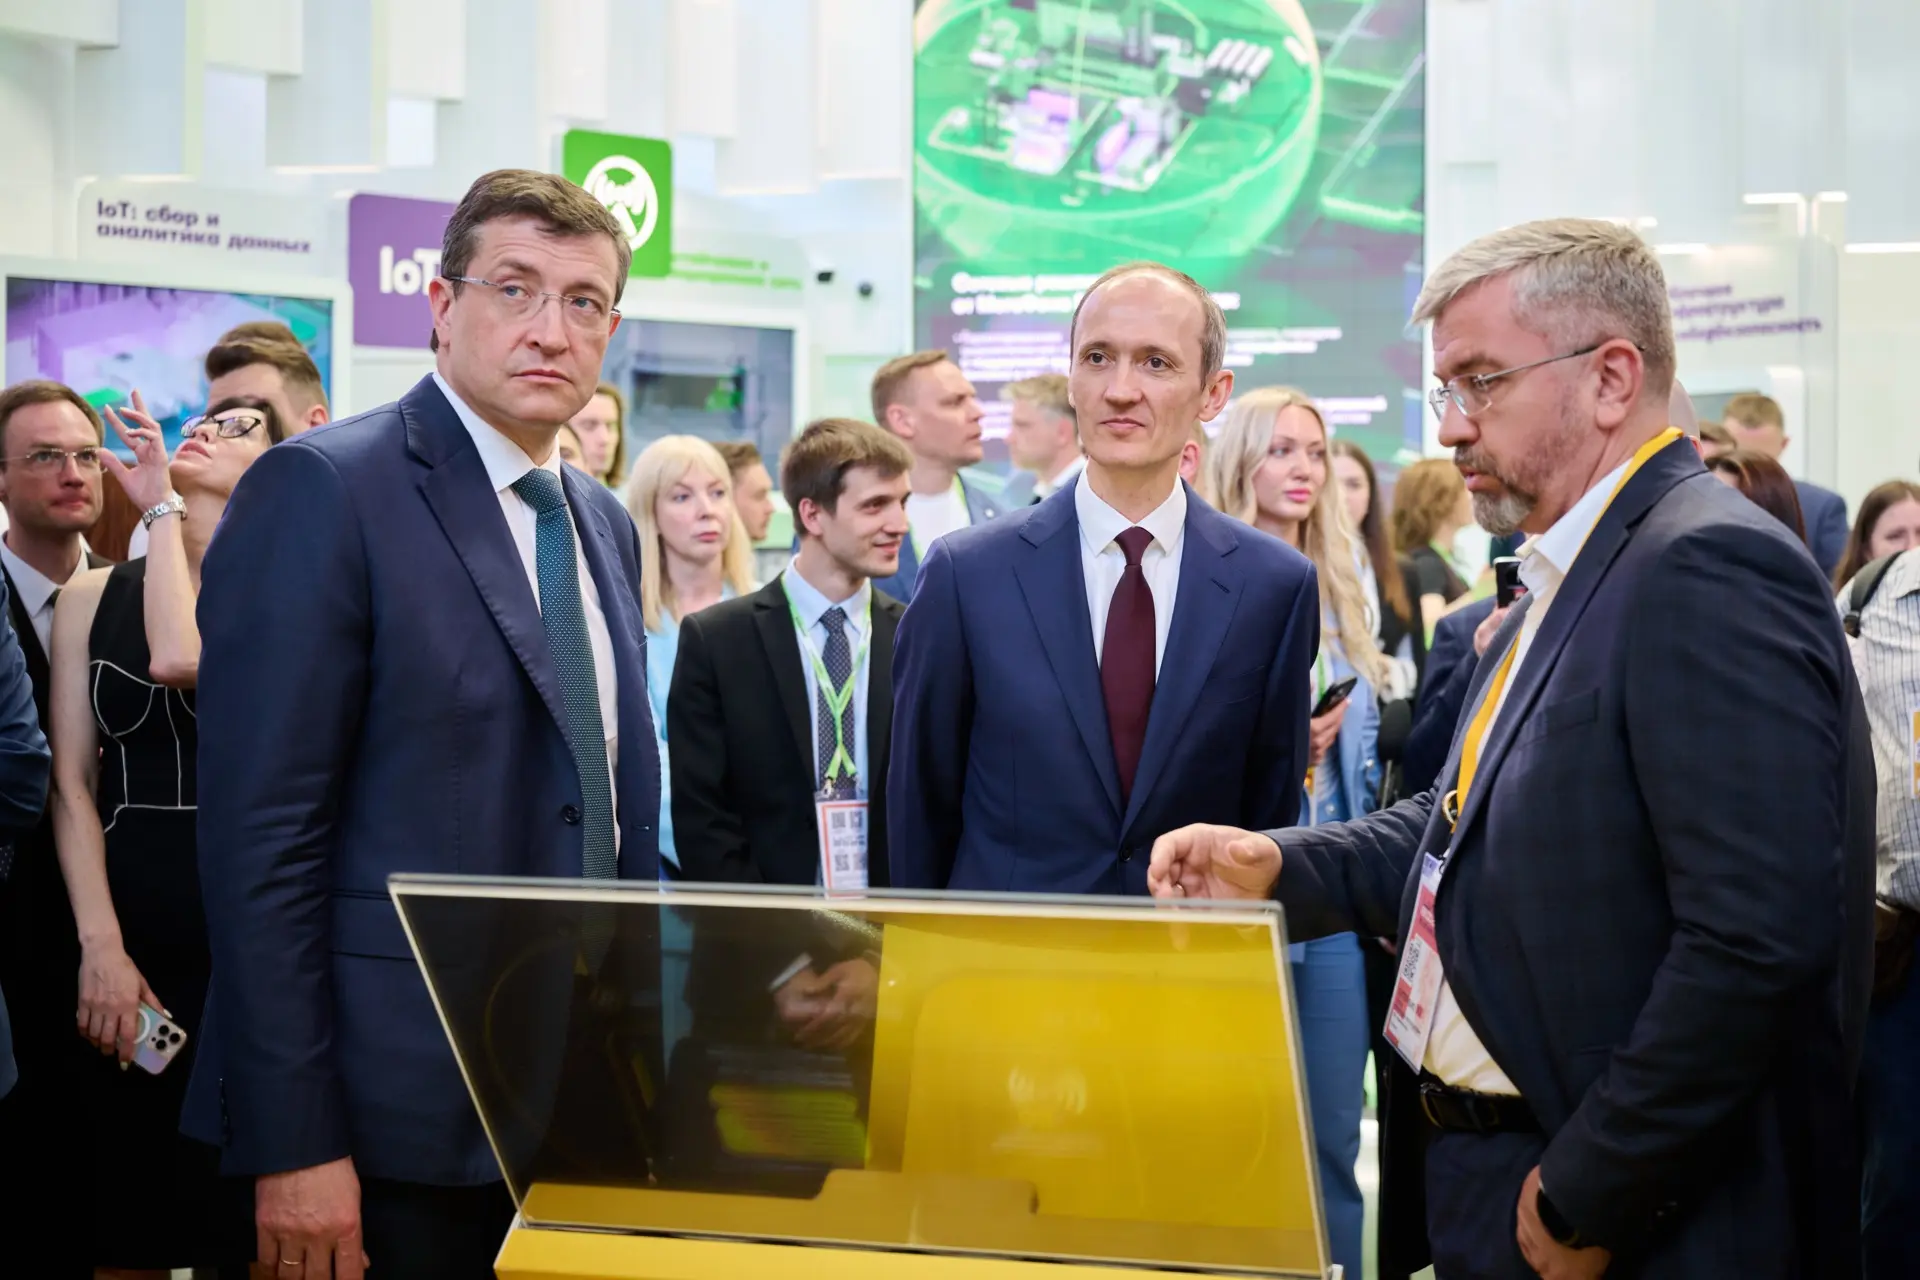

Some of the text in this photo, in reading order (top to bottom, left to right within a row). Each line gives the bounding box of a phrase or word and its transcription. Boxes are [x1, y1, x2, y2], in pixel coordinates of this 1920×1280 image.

[98, 201, 220, 226] IoT: сбор и
[97, 222, 311, 254] аналитика данных
[379, 246, 442, 295] IoT
